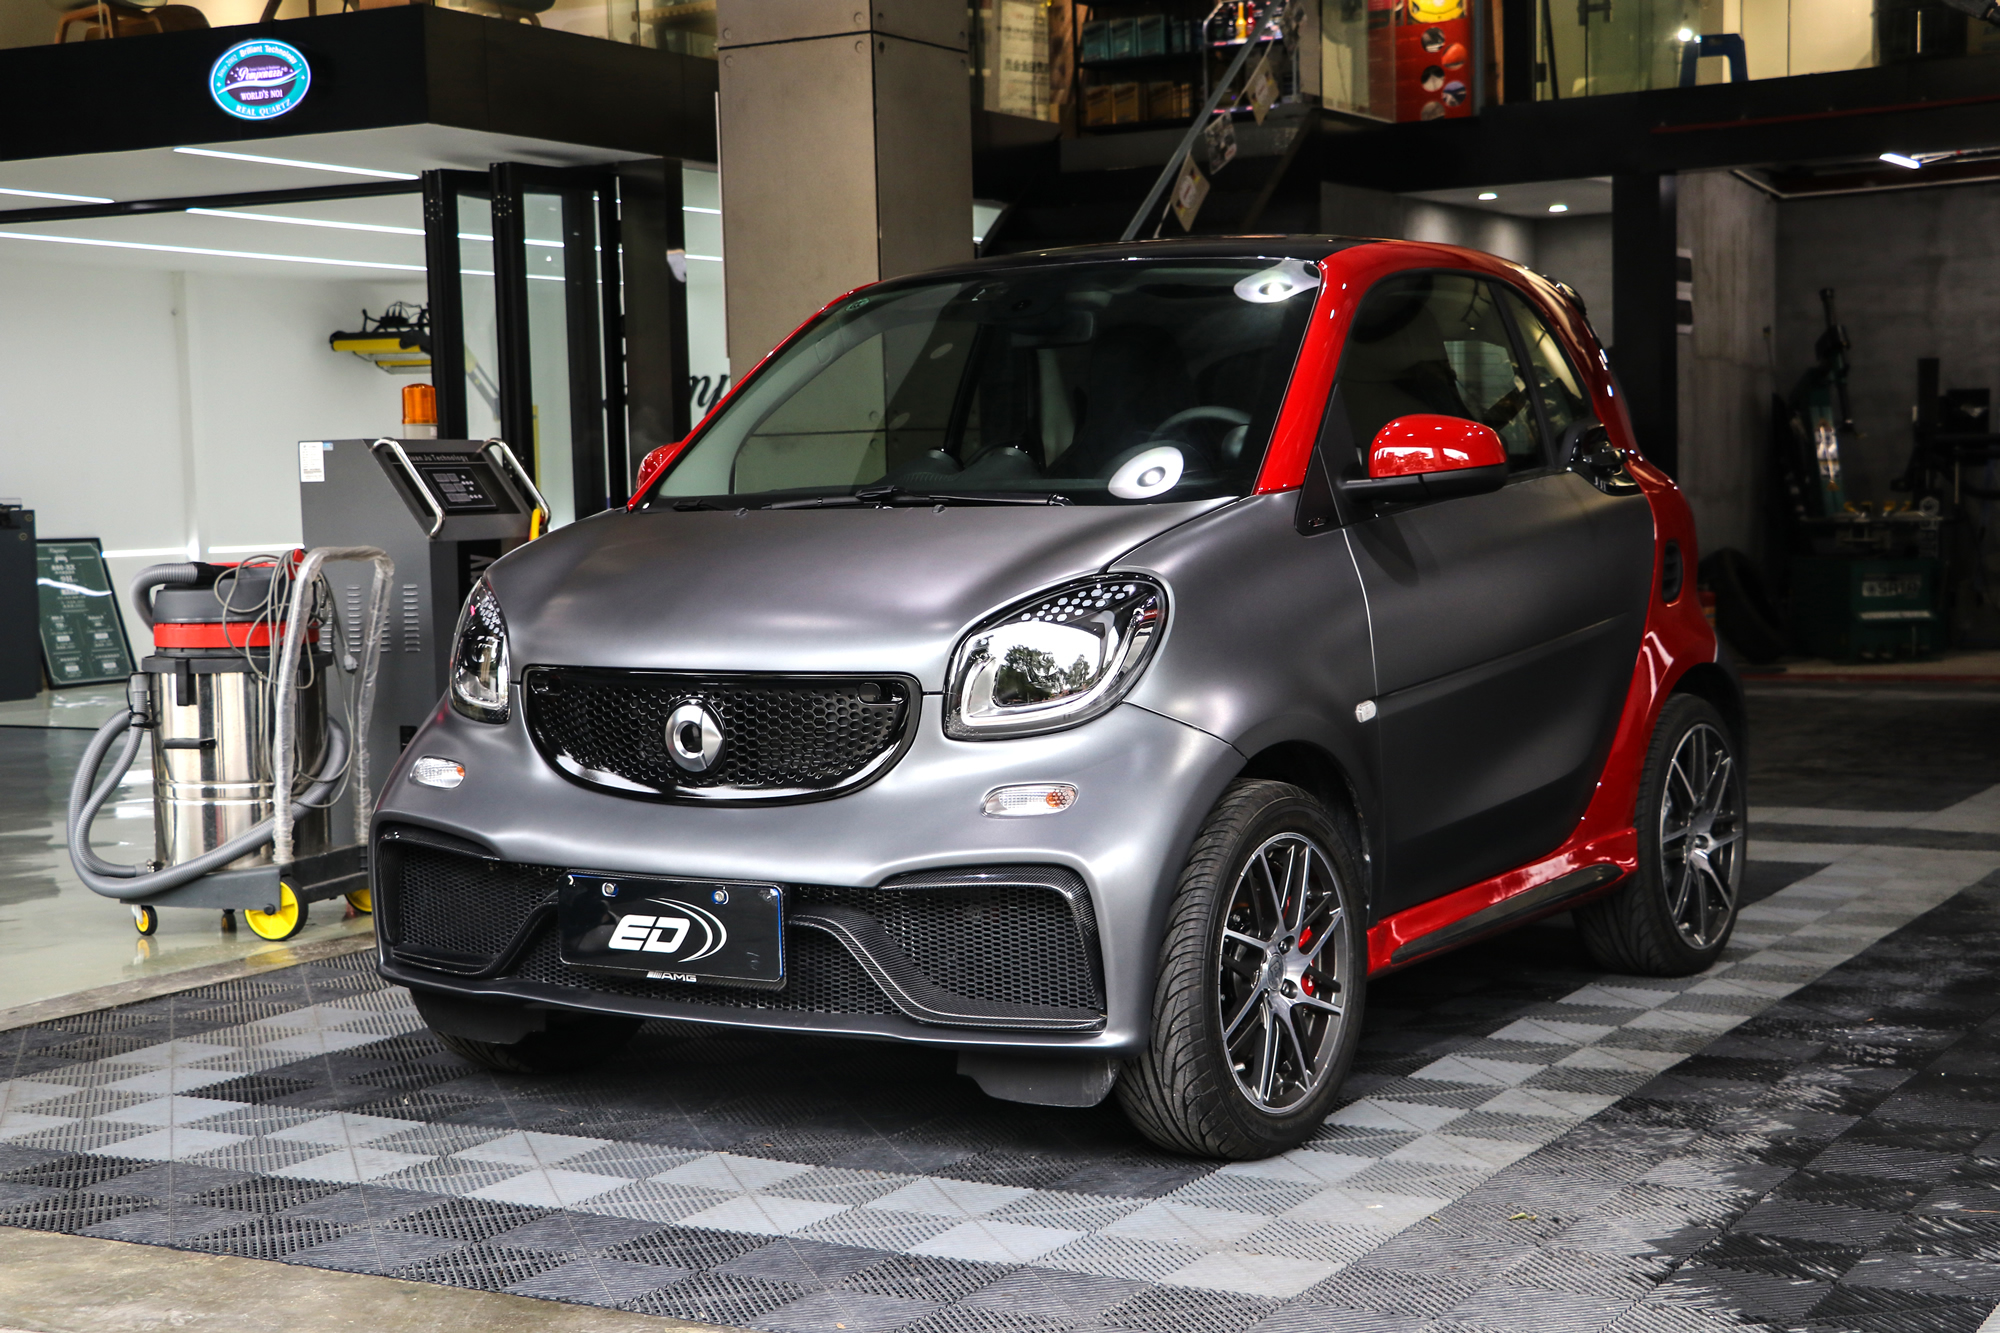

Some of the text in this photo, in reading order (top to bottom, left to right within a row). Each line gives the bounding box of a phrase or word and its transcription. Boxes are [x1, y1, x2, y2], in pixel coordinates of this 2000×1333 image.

[239, 45, 298, 64] Brilliant Technology
[240, 89, 269, 101] WORLD'S
[235, 98, 291, 117] REAL QUARTZ
[431, 453, 469, 462] Technology
[608, 914, 691, 953] ED
[661, 972, 697, 983] AMG
